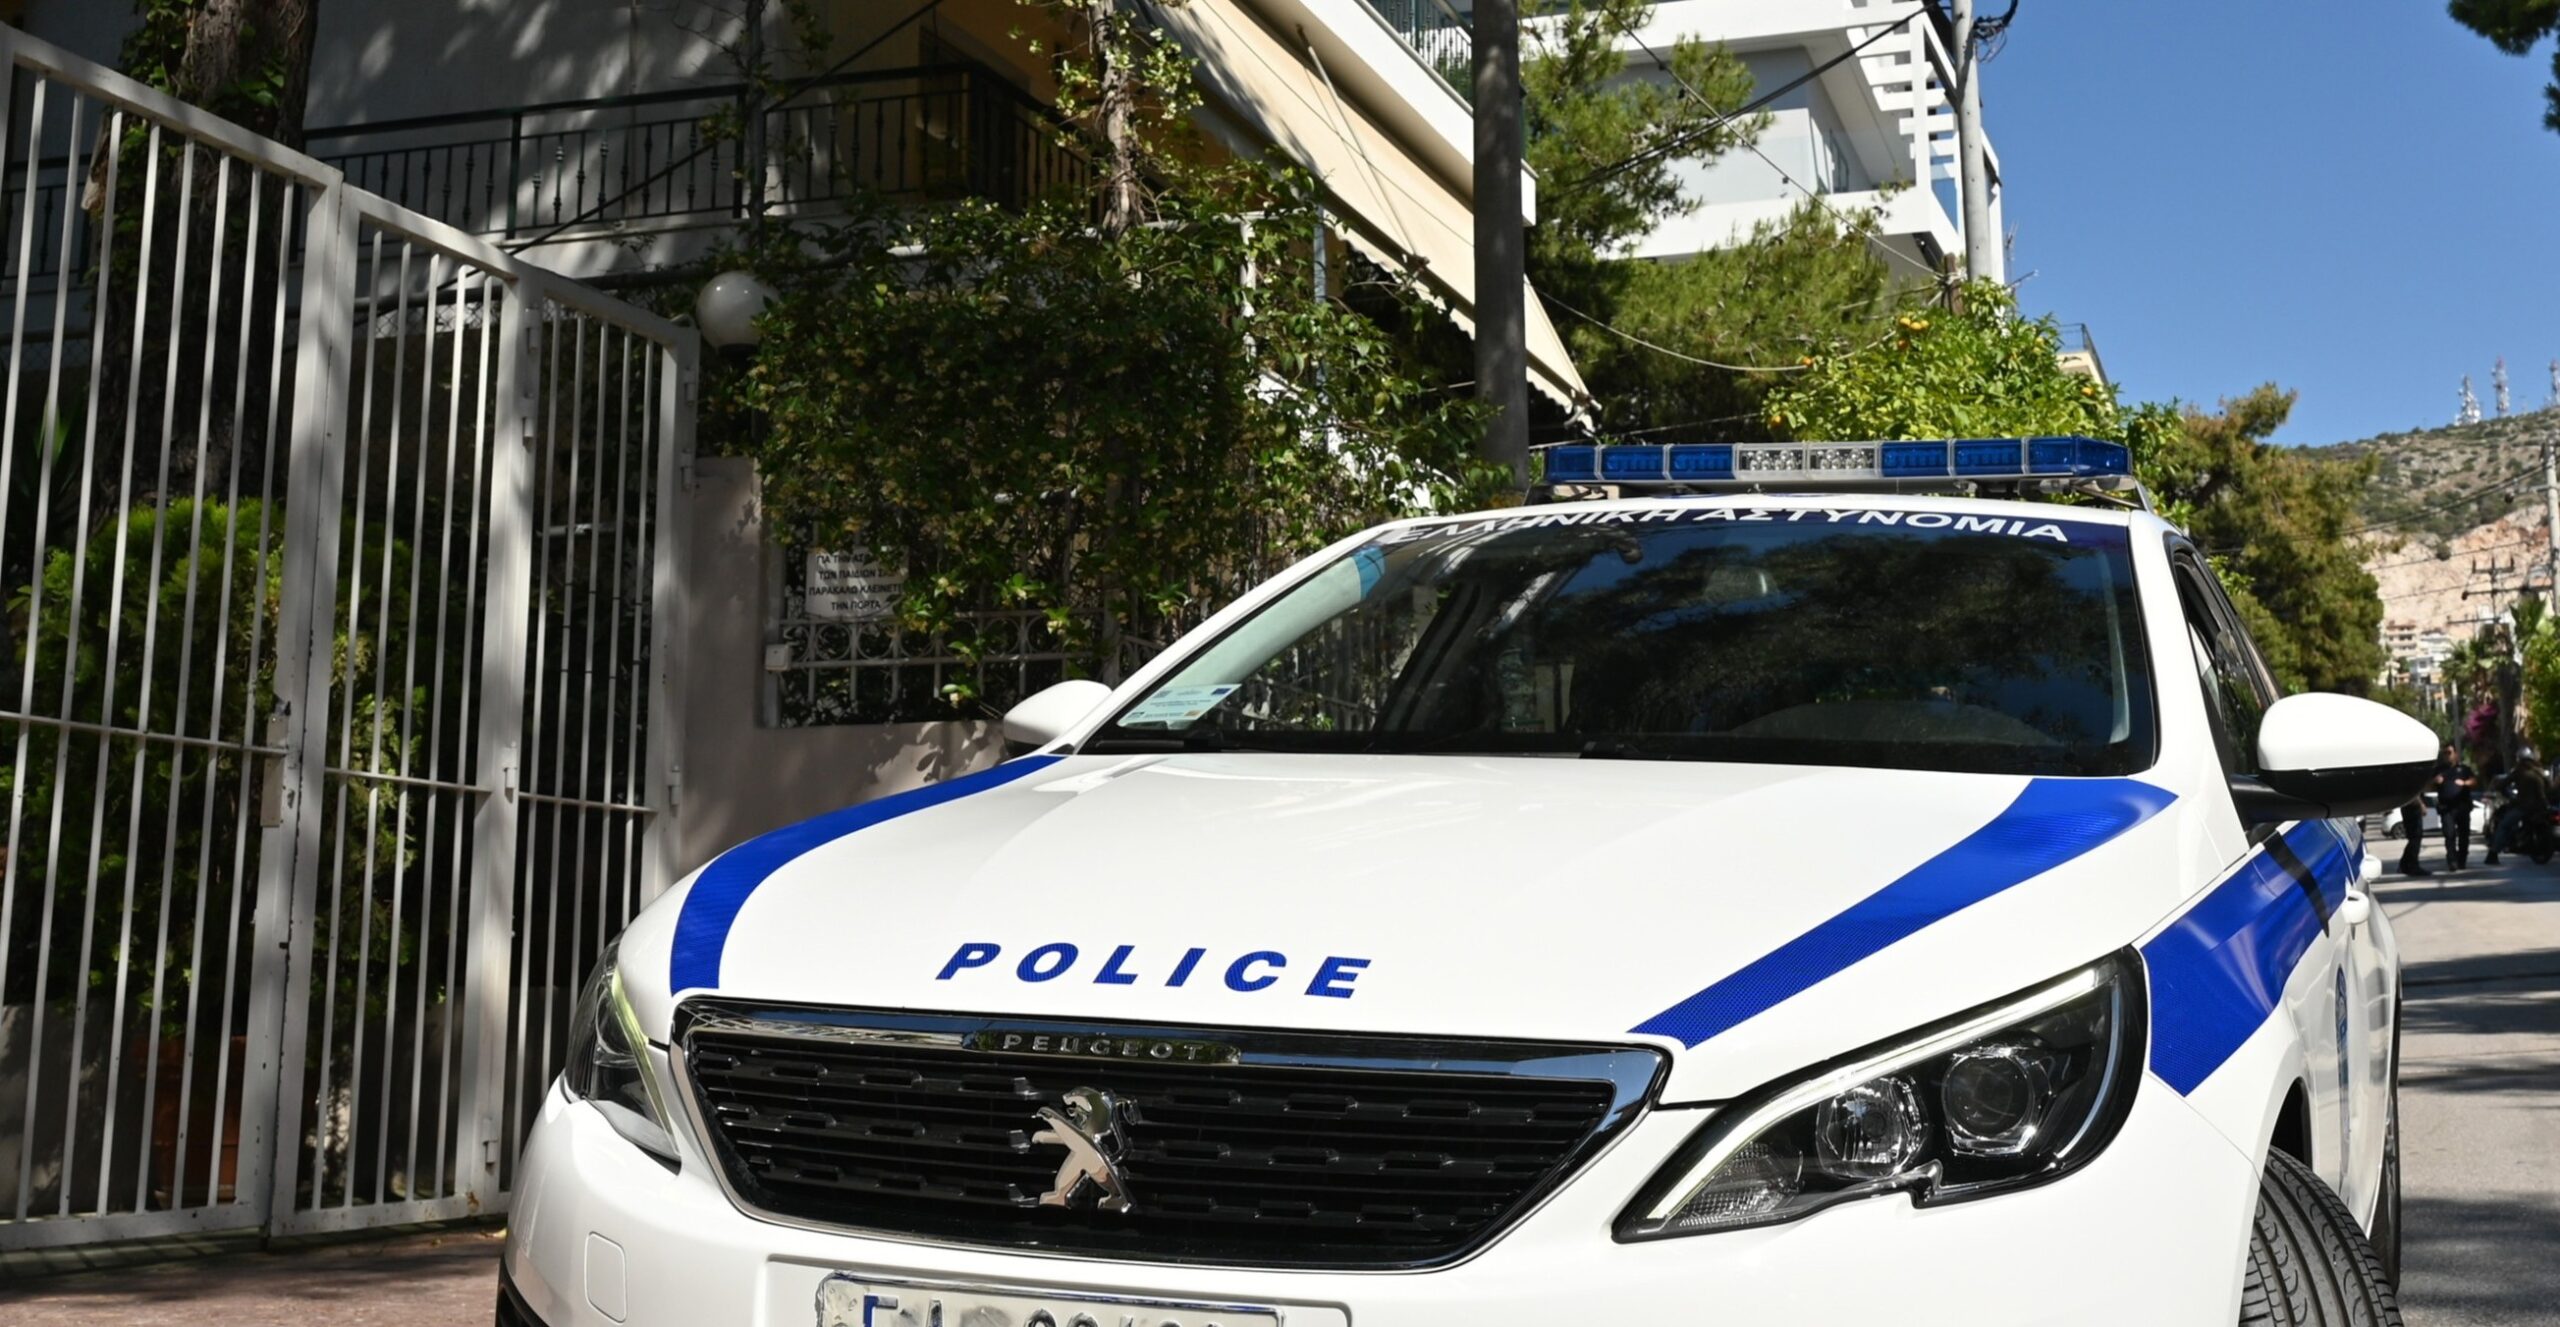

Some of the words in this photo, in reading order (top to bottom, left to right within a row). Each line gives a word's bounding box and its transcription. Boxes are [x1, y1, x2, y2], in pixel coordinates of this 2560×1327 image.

[1692, 508, 2069, 543] ΑΣΤΥΝΟΜΙΑ
[935, 942, 1371, 999] POLICE
[1002, 1034, 1204, 1061] PEUGEOT
